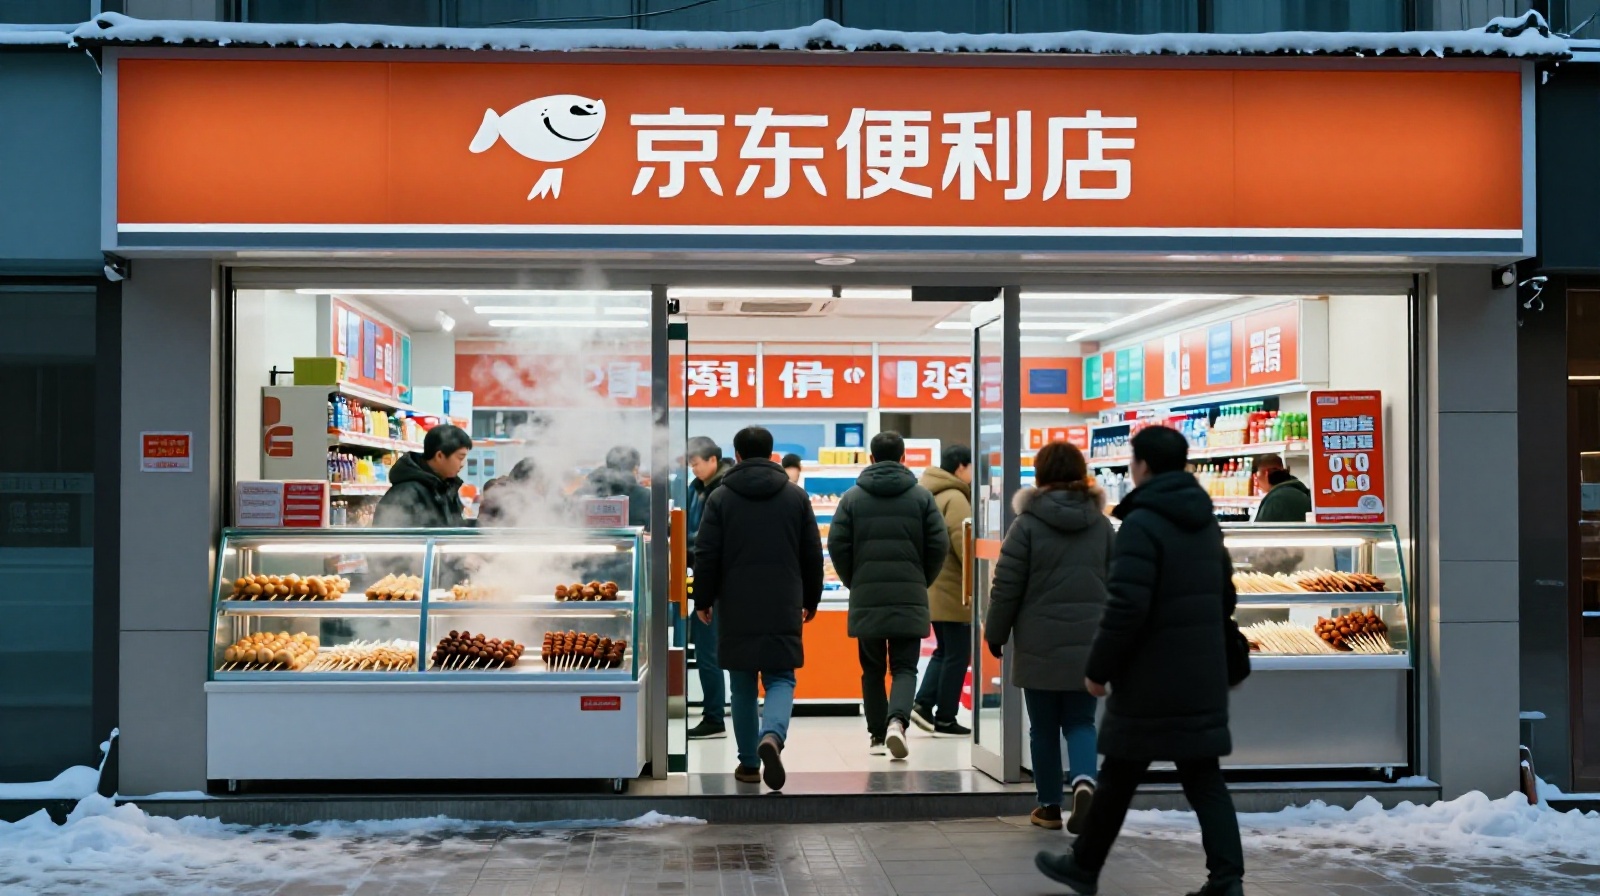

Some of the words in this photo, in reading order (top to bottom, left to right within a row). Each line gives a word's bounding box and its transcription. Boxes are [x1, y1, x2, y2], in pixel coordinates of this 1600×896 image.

[630, 107, 1137, 200] 京东便利店
